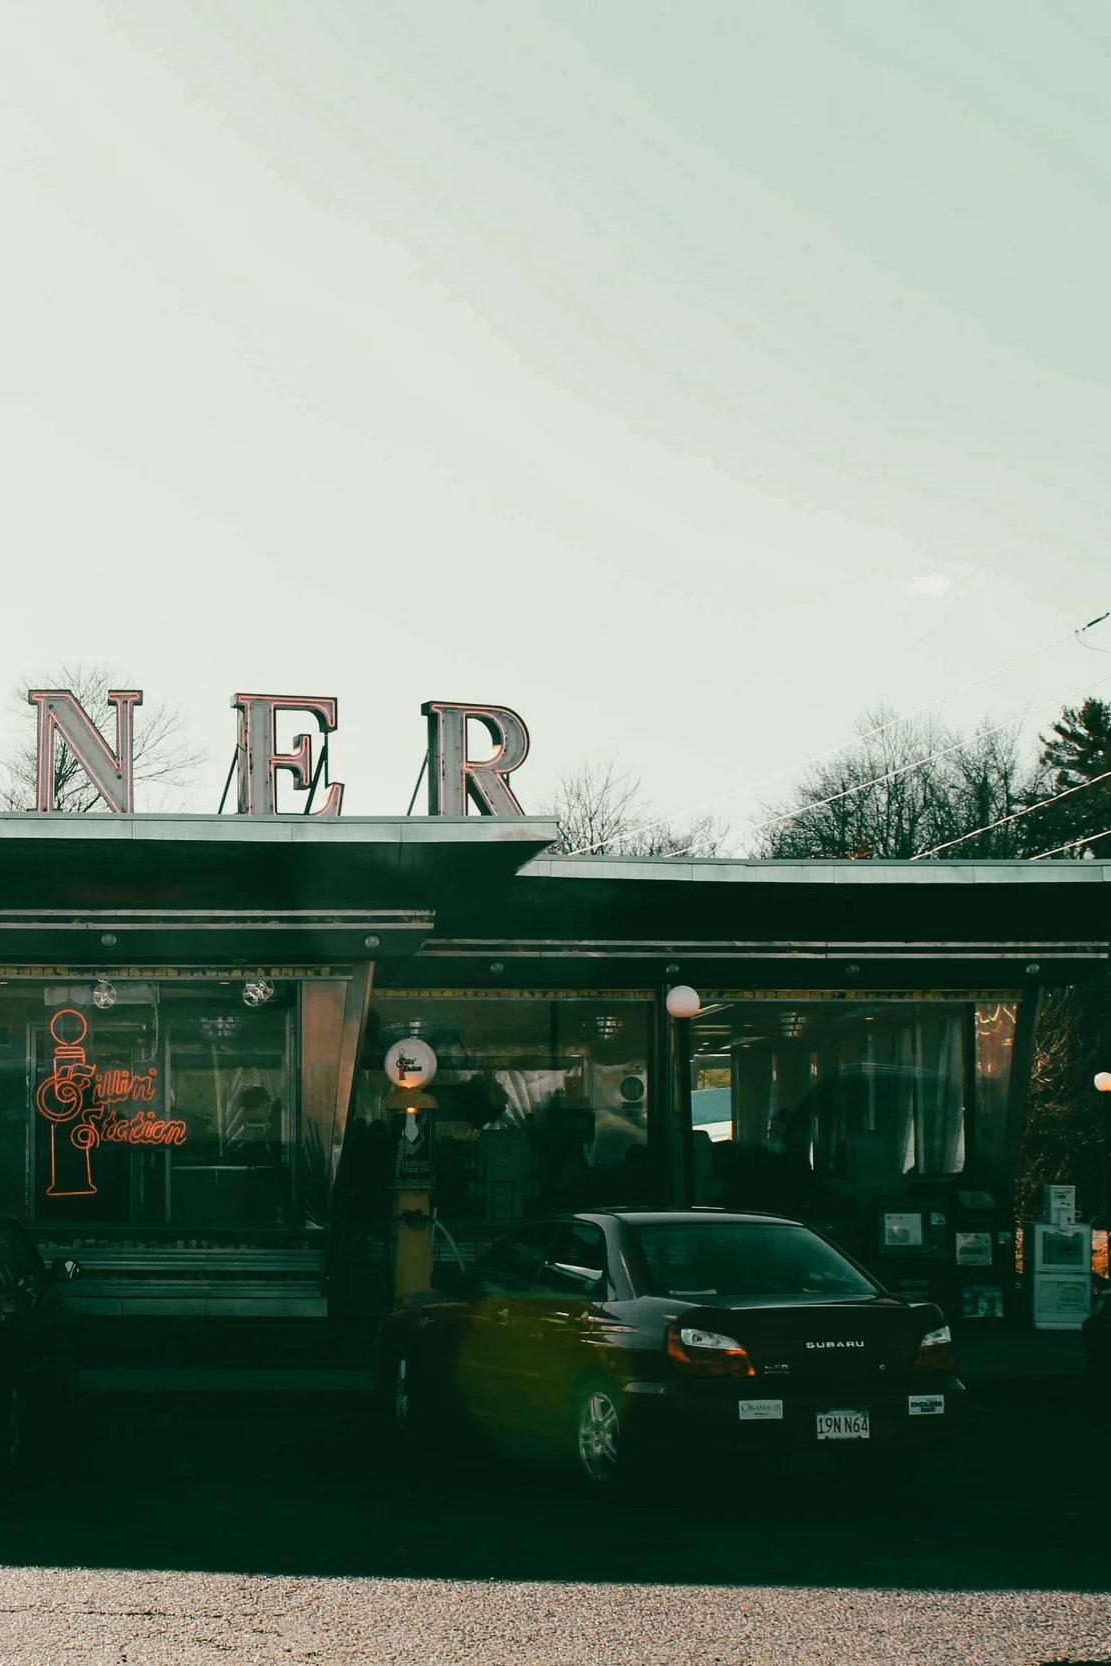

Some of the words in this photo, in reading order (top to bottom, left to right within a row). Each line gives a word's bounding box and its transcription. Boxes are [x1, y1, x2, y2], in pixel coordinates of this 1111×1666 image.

[70, 1104, 188, 1150] Station
[805, 1340, 865, 1349] SUBARU
[818, 1416, 842, 1434] 19N
[845, 1416, 868, 1434] N64
